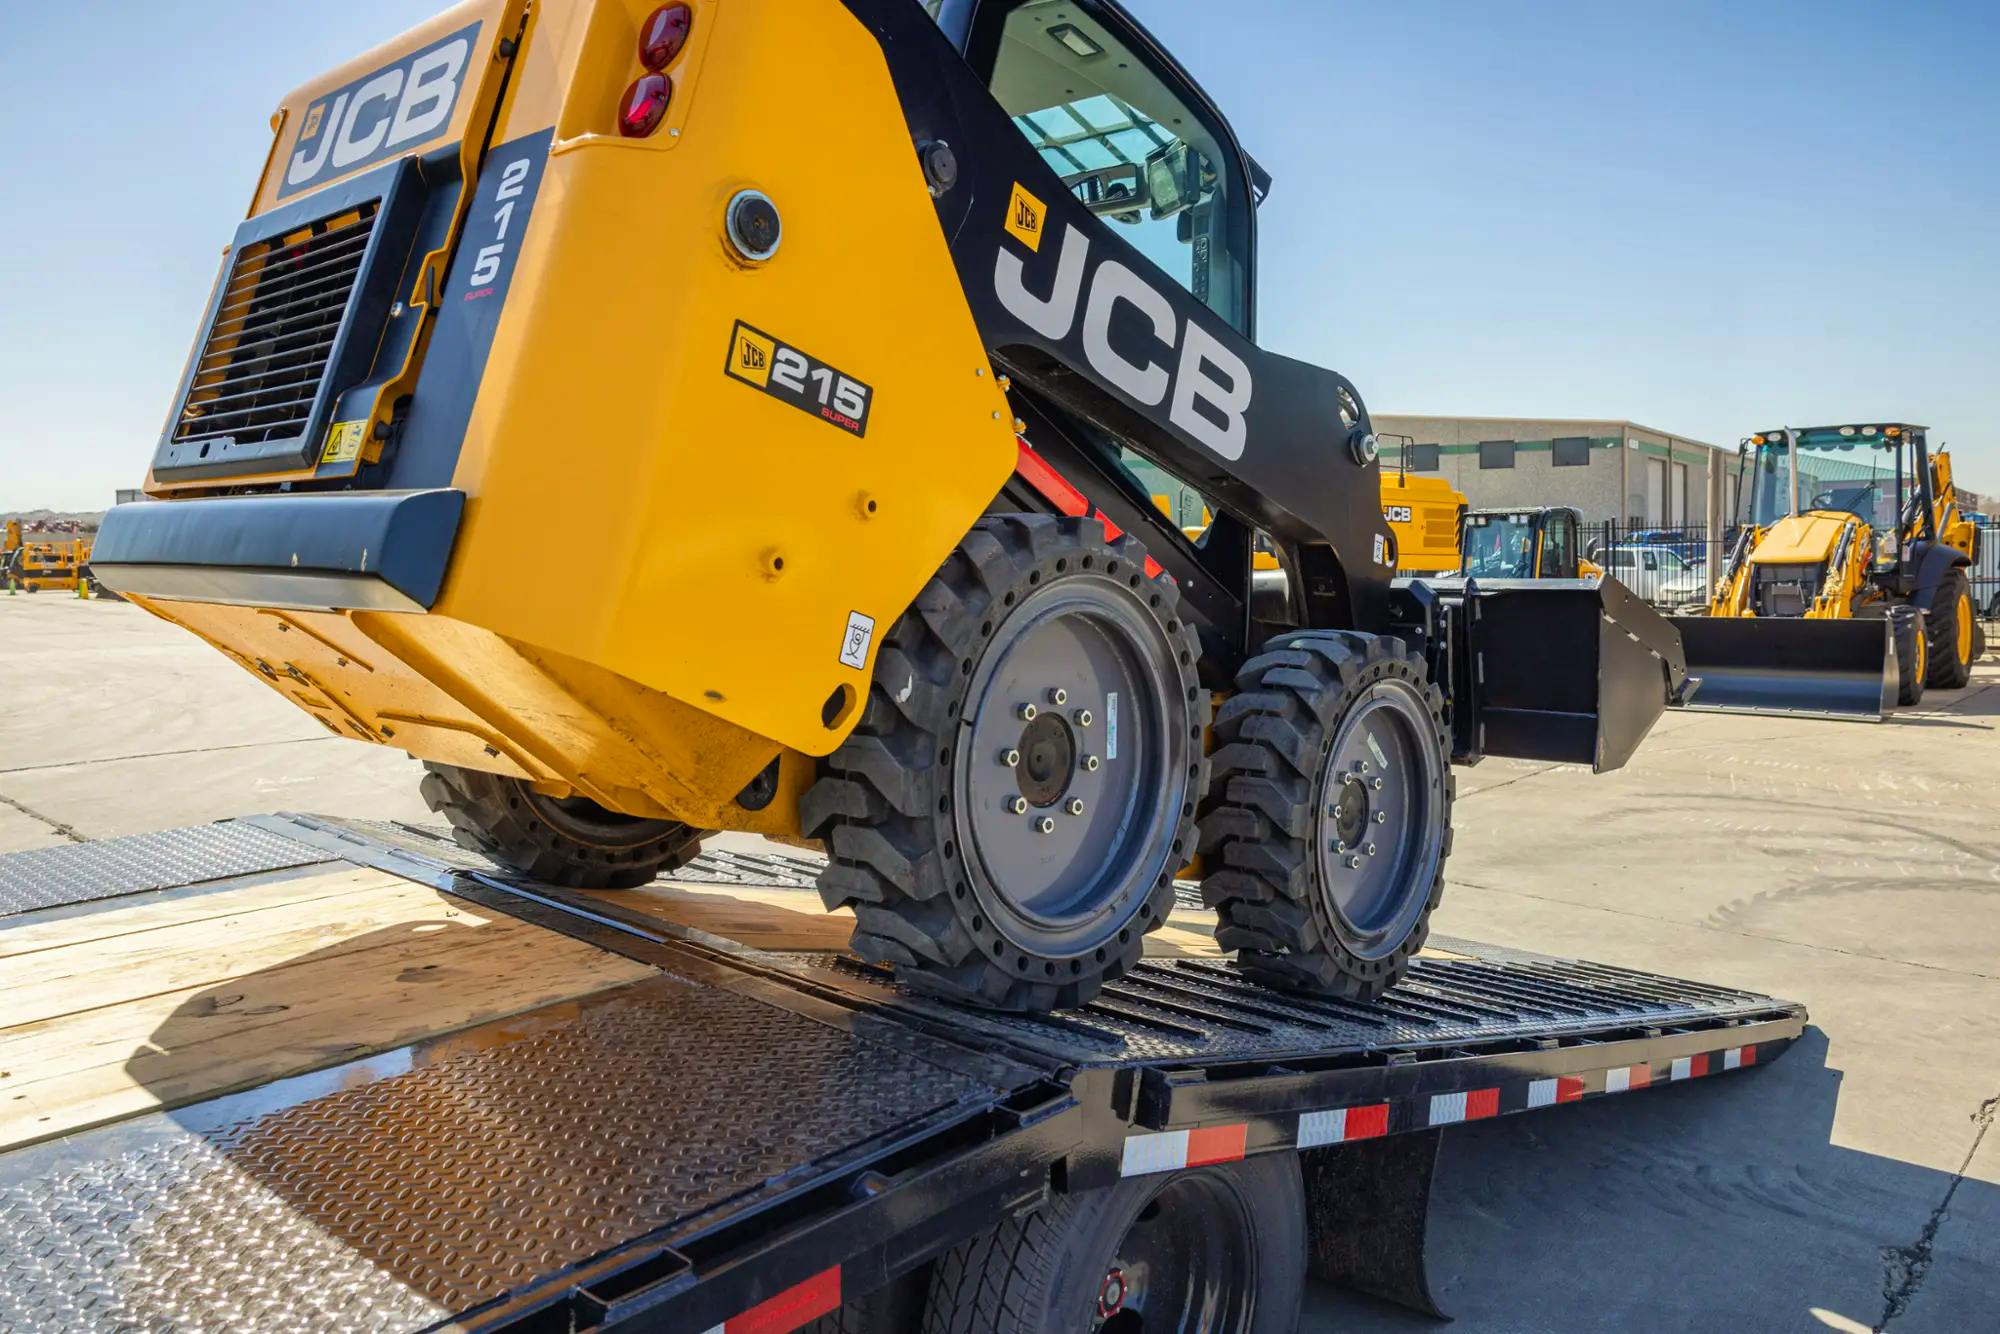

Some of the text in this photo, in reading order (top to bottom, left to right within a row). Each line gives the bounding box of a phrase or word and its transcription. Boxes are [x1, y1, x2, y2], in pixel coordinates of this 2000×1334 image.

[288, 39, 468, 184] JCB
[470, 158, 530, 286] 215
[1017, 201, 1036, 229] JCB
[994, 223, 1252, 461] JCB
[744, 343, 866, 420] JCB 215
[822, 407, 860, 431] SUPER
[1384, 506, 1411, 521] JCB
